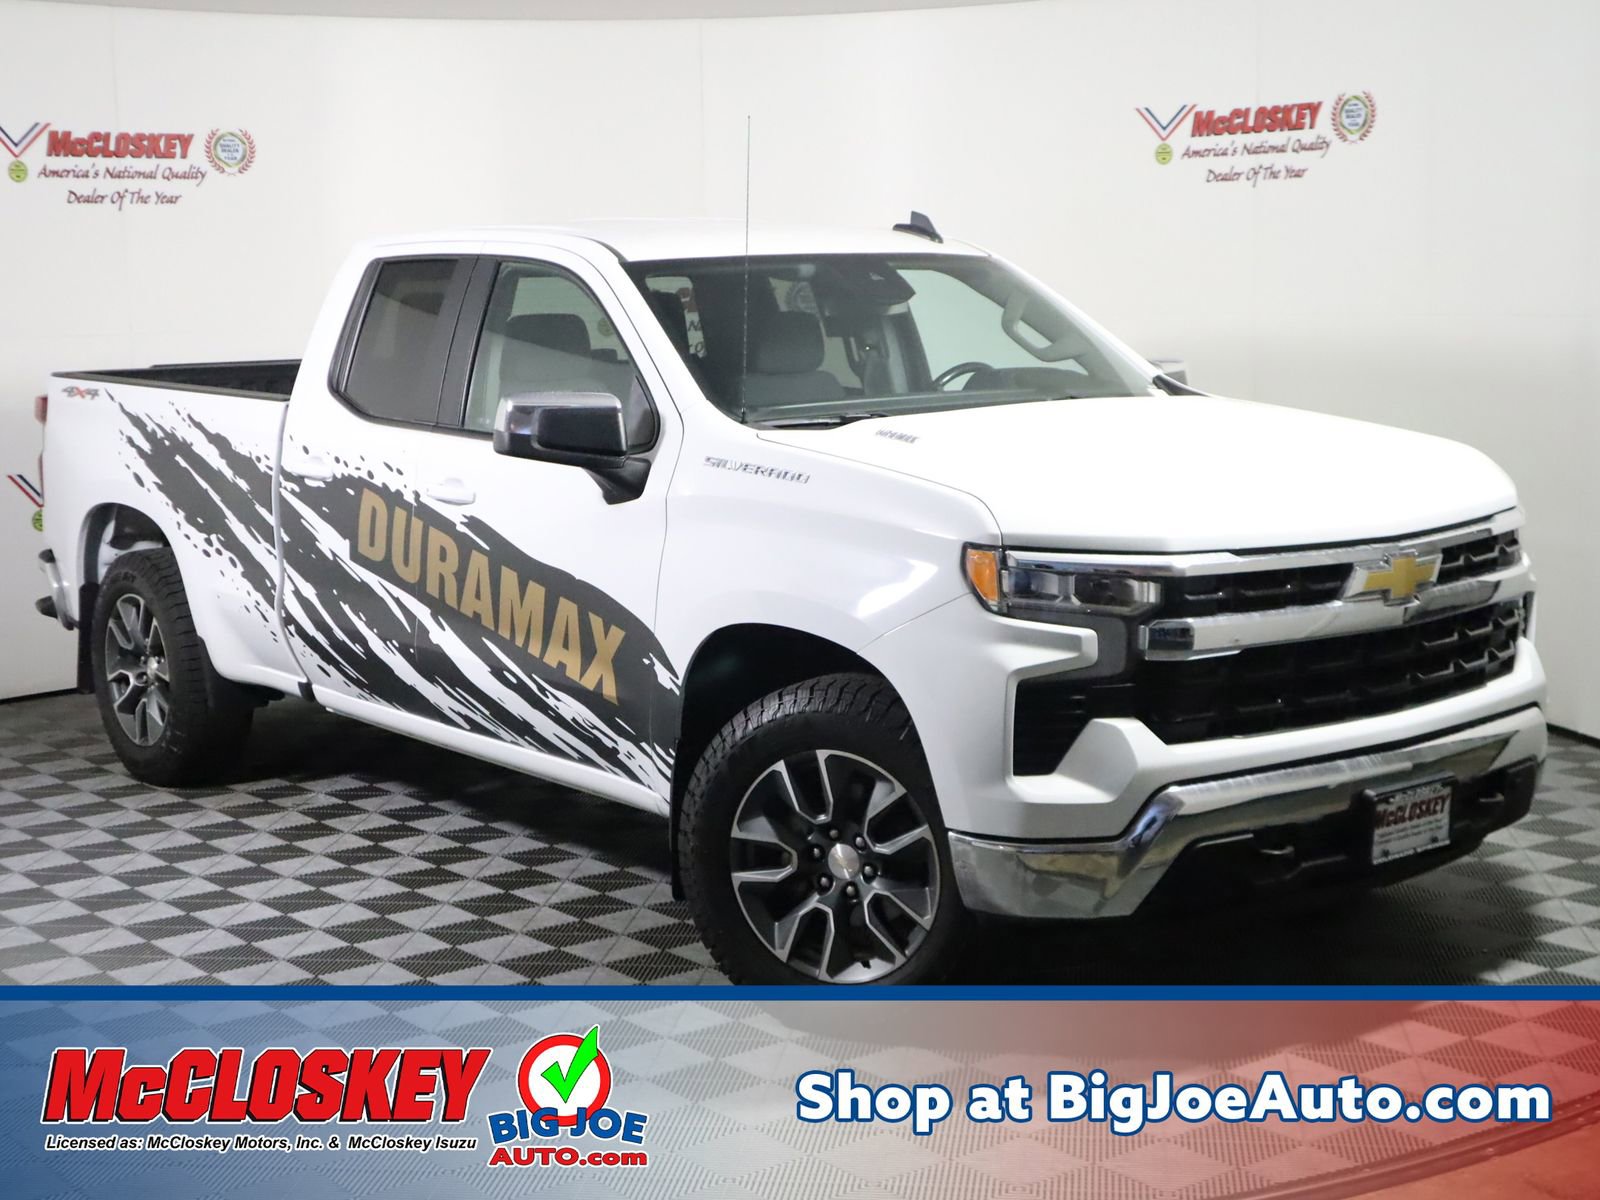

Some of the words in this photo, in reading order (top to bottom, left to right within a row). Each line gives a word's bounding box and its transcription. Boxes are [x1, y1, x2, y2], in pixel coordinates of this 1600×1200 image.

[1191, 101, 1324, 138] McCLOSKEY
[46, 130, 194, 159] McCLOSKEY
[1181, 141, 1239, 160] America's
[1243, 137, 1288, 155] National
[1291, 134, 1332, 159] Quality
[37, 163, 100, 181] America's
[103, 164, 157, 181] National
[161, 164, 208, 188] Quality
[1206, 166, 1244, 184] Dealer
[1245, 165, 1262, 188] Of
[1263, 163, 1282, 180] The
[1283, 165, 1309, 179] Year
[66, 189, 108, 205] Dealer
[110, 189, 128, 212] Of
[128, 189, 152, 205] The
[154, 190, 182, 205] Year
[703, 455, 811, 484] SILVERADO
[356, 487, 627, 706] DURAMAX
